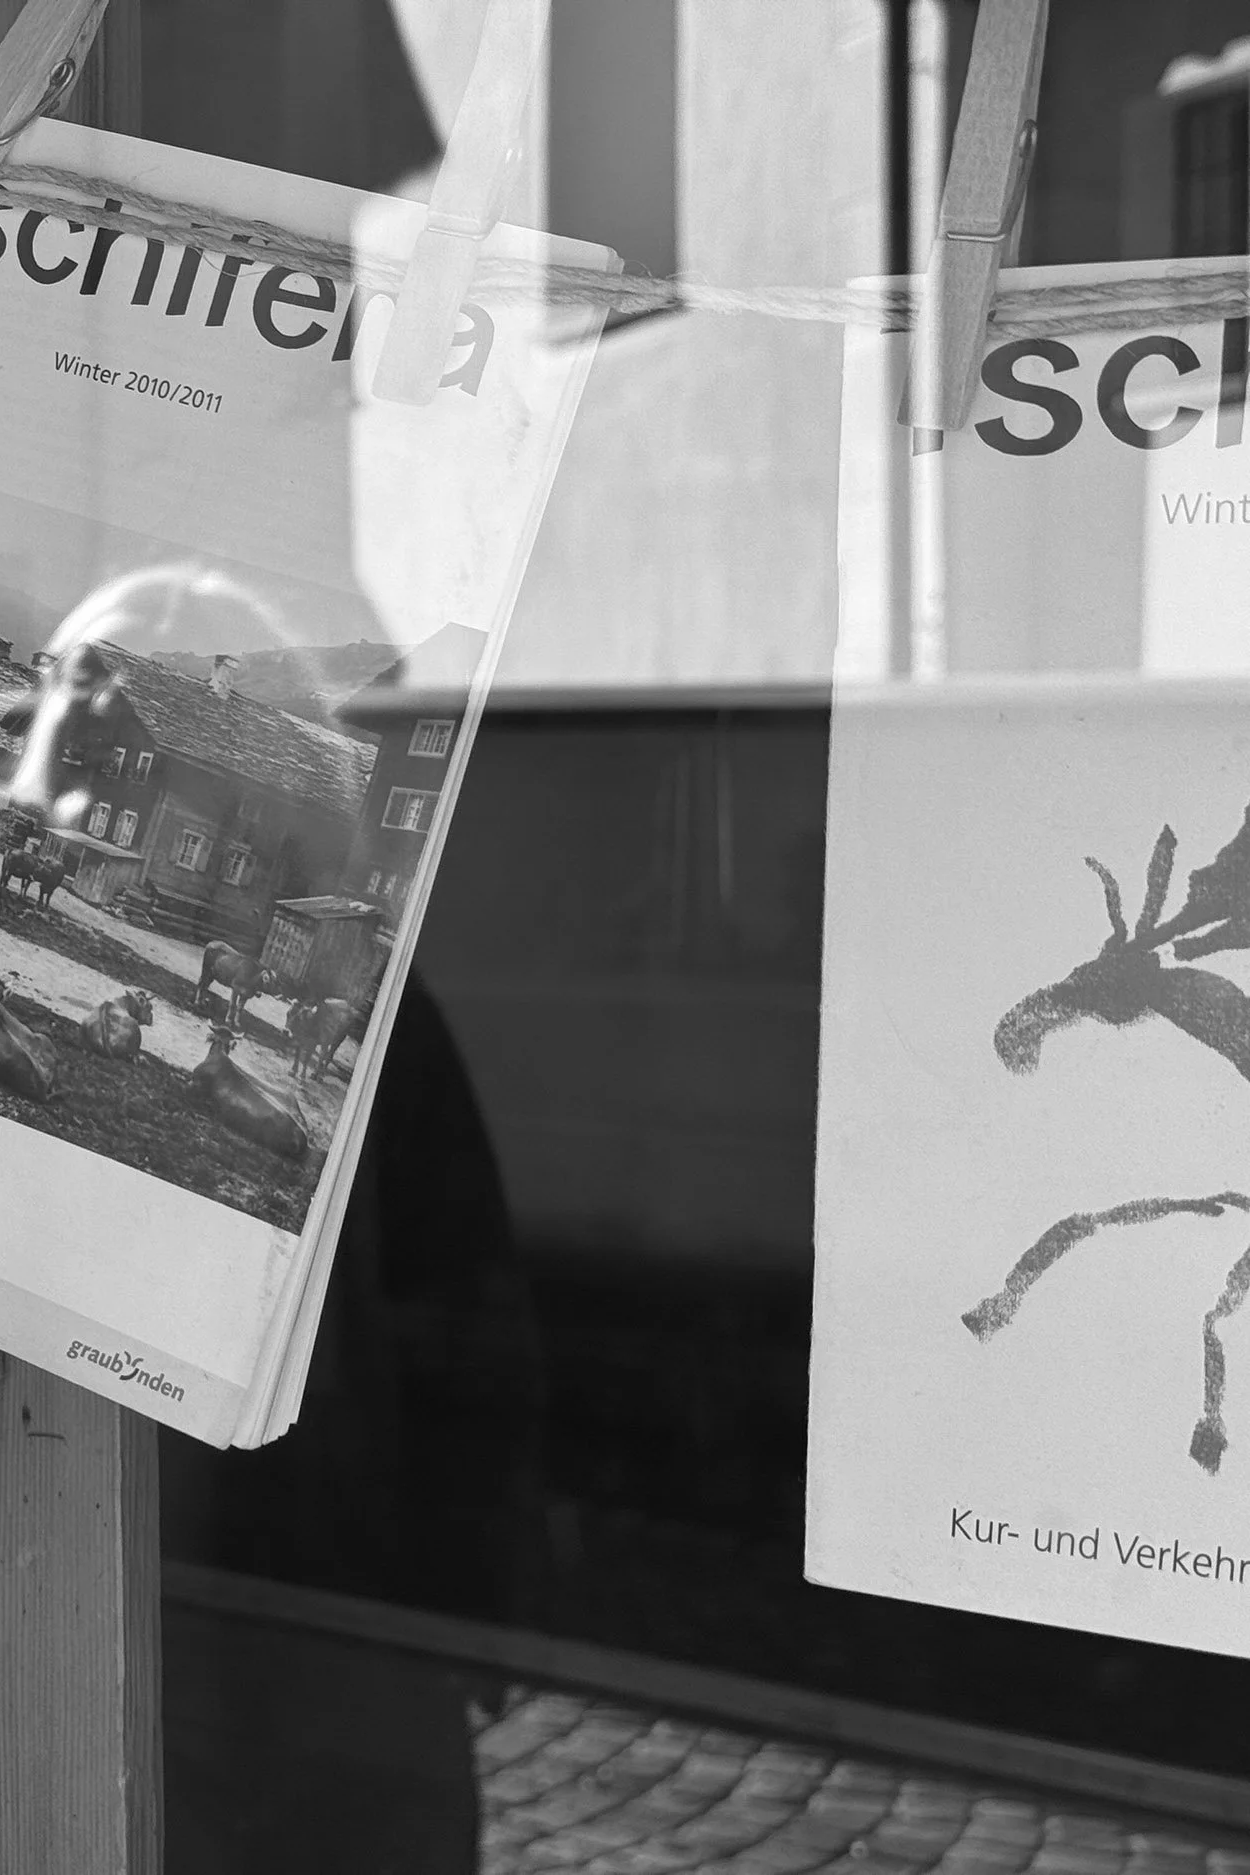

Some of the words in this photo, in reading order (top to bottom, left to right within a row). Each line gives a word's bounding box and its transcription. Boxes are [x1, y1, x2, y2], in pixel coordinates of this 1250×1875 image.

[54, 350, 122, 387] Winter
[124, 370, 223, 414] 2010/2011
[950, 1507, 1020, 1546] Kur-
[1033, 1527, 1100, 1560] und
[1112, 1531, 1250, 1585] Verkehr
